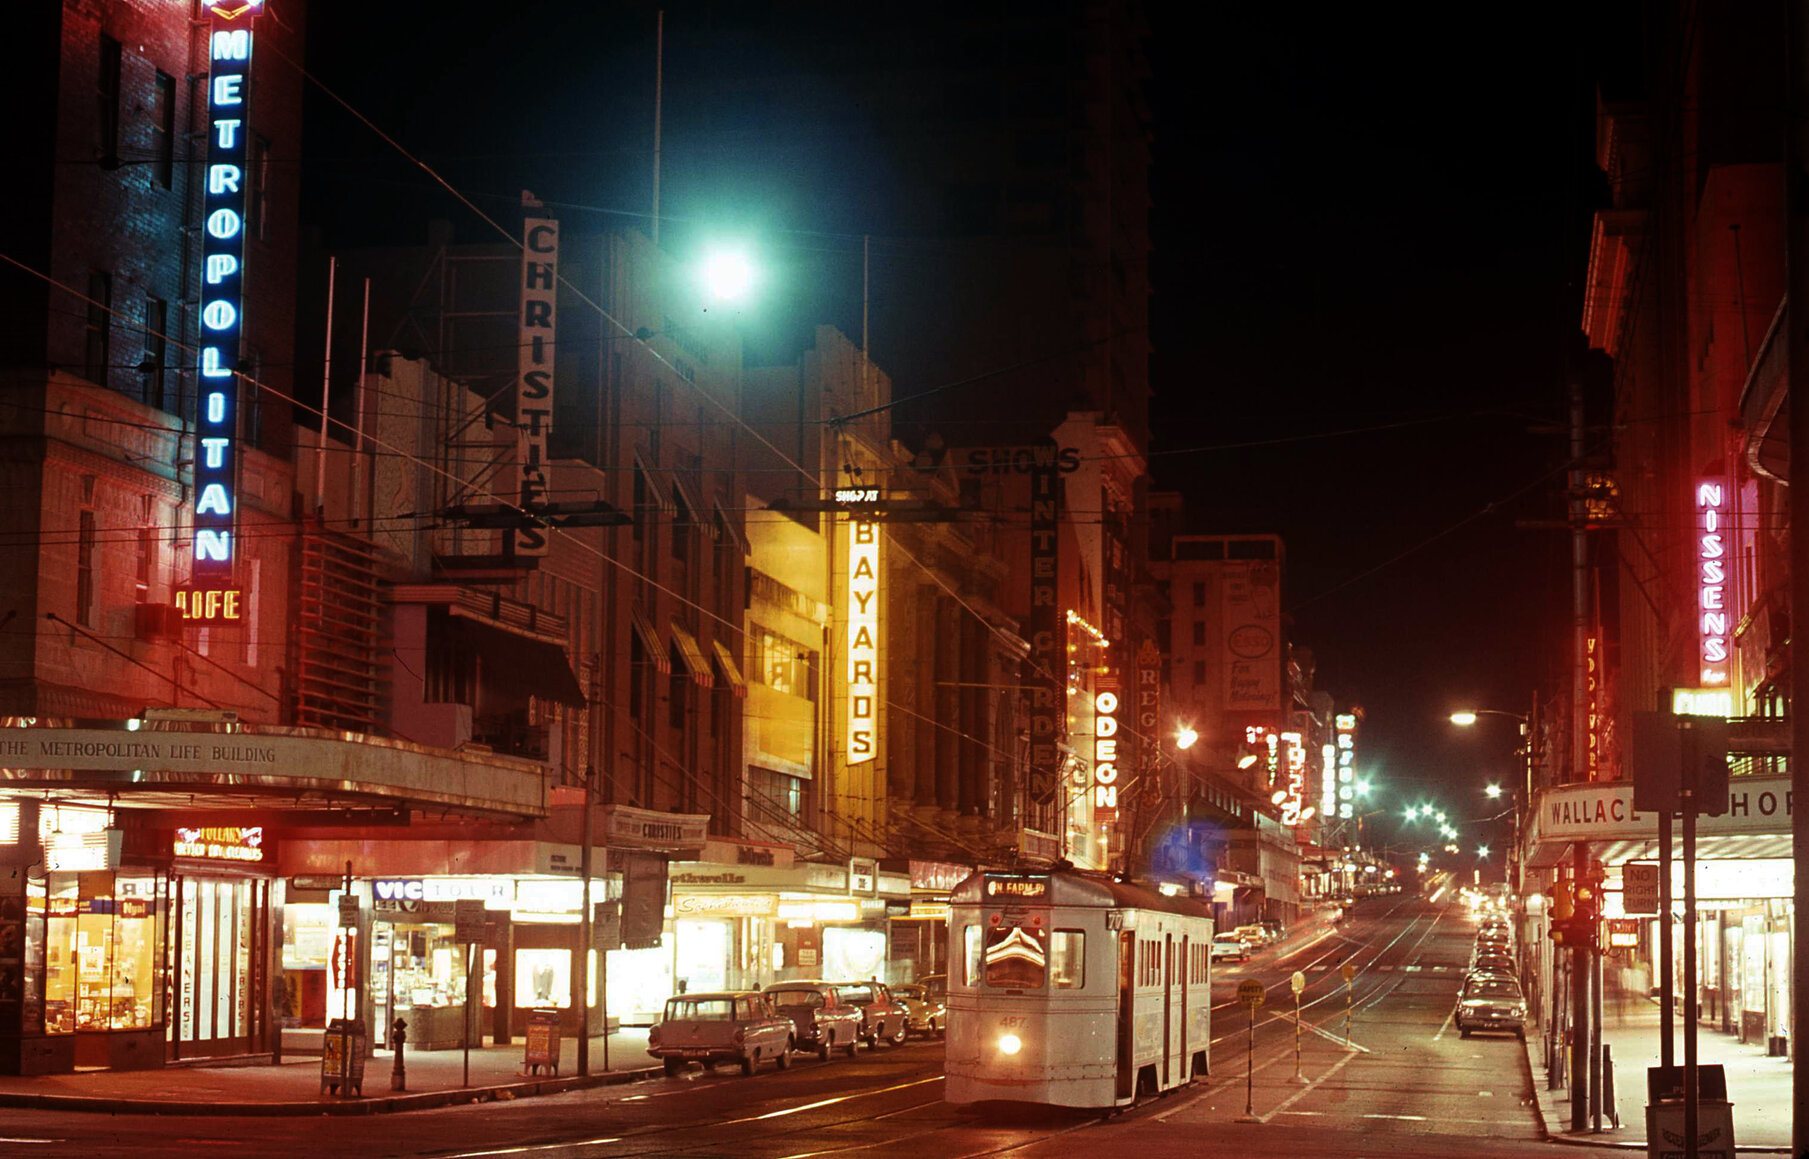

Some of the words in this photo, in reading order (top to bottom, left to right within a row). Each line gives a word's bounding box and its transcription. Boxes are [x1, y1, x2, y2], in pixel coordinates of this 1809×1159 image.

[196, 30, 248, 561] METROPOLITAN
[517, 225, 556, 550] CHRISTIES
[835, 490, 864, 502] SHOP
[864, 490, 879, 501] AT
[967, 448, 1080, 475] SHOS
[1033, 446, 1056, 606] WINTER
[176, 590, 240, 619] LIFE
[1700, 484, 1728, 662] NISSENS
[852, 521, 875, 755] BAYARDS
[1031, 632, 1054, 796] GARDEN
[0, 741, 28, 756] THE
[40, 741, 161, 759] METROPOLITAN
[170, 744, 200, 760] LIFE
[212, 746, 275, 763] BUILDING
[1096, 692, 1118, 807] ODEON
[671, 873, 745, 884] othwells
[1626, 885, 1656, 897] RIGHT
[1627, 898, 1655, 908] TURN
[1630, 870, 1650, 882] NO
[183, 911, 192, 1022] CLEANERS
